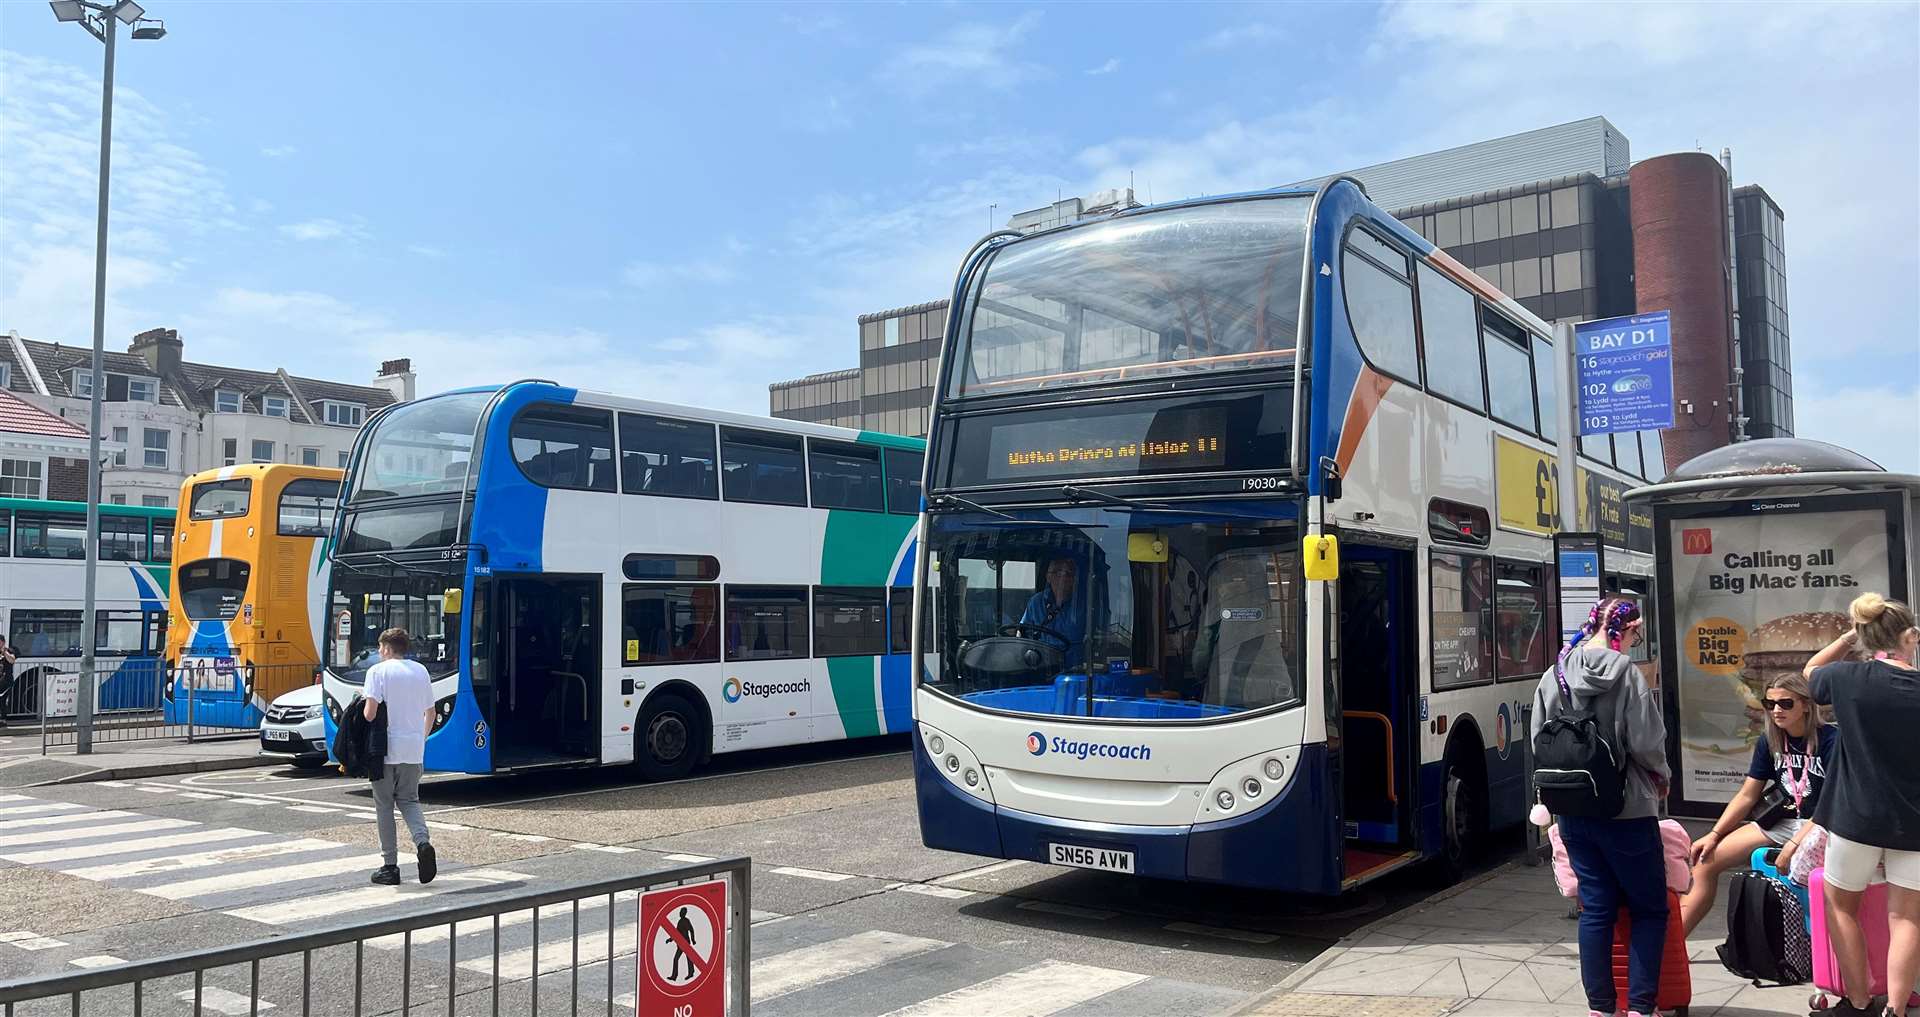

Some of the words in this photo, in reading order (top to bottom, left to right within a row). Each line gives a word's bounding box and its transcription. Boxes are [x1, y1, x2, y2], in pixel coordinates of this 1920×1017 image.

[1590, 332, 1625, 350] BAY
[1632, 329, 1655, 345] D1
[1581, 356, 1597, 369] 16
[1647, 350, 1668, 361] gold
[1582, 383, 1607, 396] 102
[1593, 397, 1609, 405] Lydd
[1583, 416, 1609, 429] 103
[1242, 477, 1276, 489] 19030
[1601, 502, 1608, 521] FX
[1724, 550, 1802, 571] Calling
[1807, 549, 1834, 566] all
[1709, 573, 1744, 594] Big
[1750, 573, 1798, 589] Mac
[1801, 572, 1859, 588] fans.
[1698, 627, 1737, 635] Double
[1699, 636, 1729, 653] Big
[1700, 652, 1739, 665] Mac
[743, 678, 811, 698] Stagecoach
[1051, 737, 1151, 760] Stagecoach
[1055, 846, 1094, 865] SN56
[1099, 851, 1128, 870] AVW
[673, 1004, 692, 1017] NO
